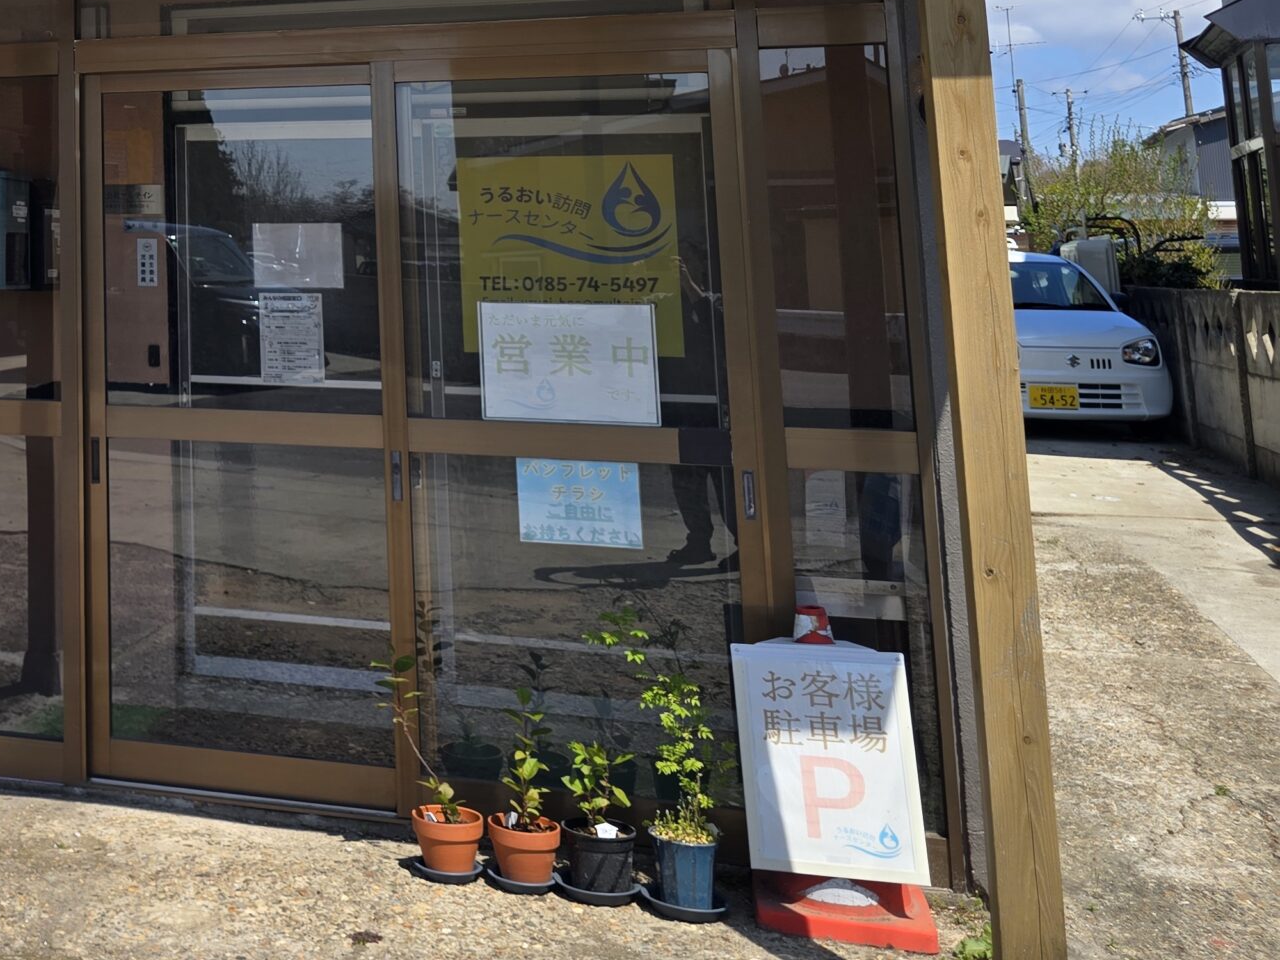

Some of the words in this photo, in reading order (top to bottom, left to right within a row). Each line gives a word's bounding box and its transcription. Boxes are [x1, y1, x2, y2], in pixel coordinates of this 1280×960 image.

[480, 187, 592, 220] うるおい訪問
[468, 208, 594, 240] ナースセンター
[479, 276, 659, 292] TEL:0185-74-5497
[488, 313, 585, 328] ただいま元気に
[491, 333, 649, 378] 営業中
[551, 486, 606, 502] チラシ
[546, 502, 614, 520] ご自由に
[522, 523, 641, 546] お持ちください
[761, 670, 885, 712] お客様
[763, 709, 887, 753] 駐車場
[799, 755, 865, 838] P
